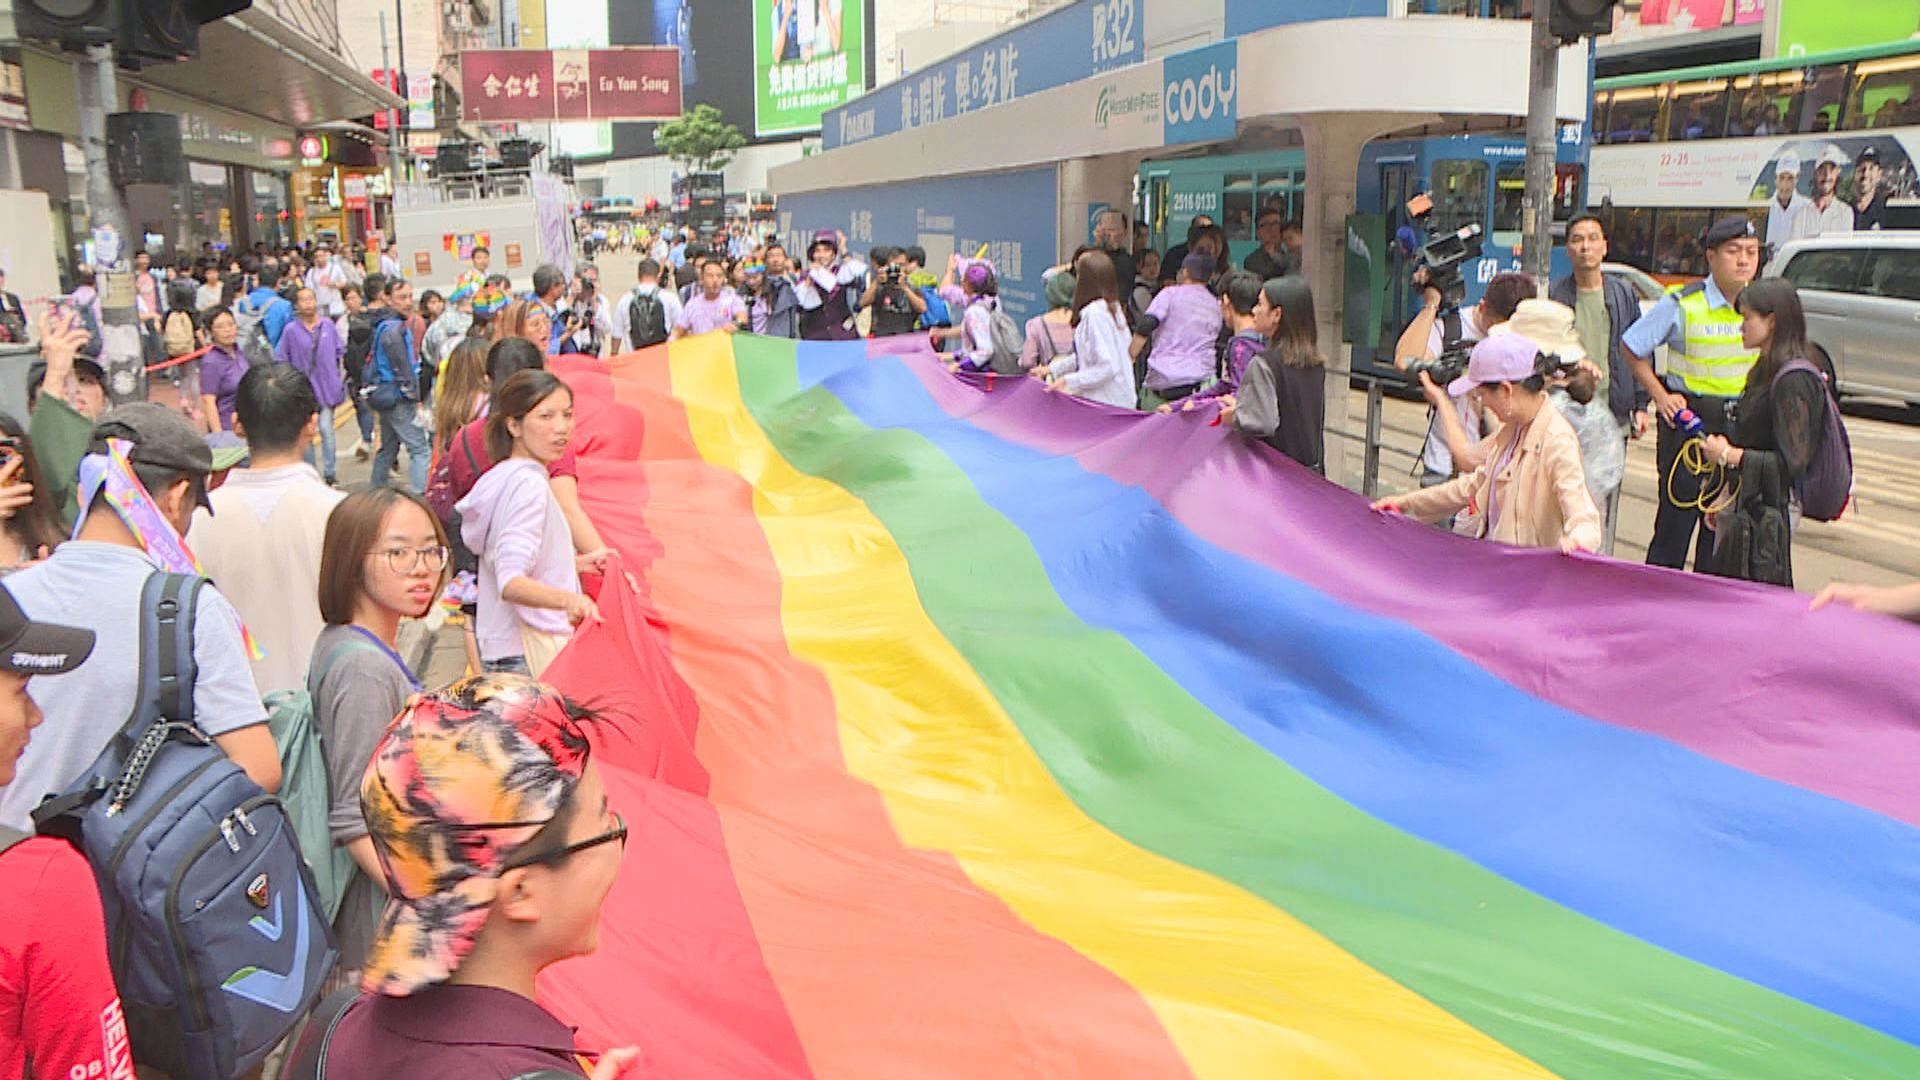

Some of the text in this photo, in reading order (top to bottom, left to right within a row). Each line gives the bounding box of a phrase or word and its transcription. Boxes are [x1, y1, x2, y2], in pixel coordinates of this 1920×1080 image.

[1092, 0, 1135, 63] R32
[482, 73, 540, 98] 余仁生
[600, 75, 670, 94] Eu Yan Sang
[1165, 64, 1236, 126] cody
[1195, 191, 1216, 211] 0133
[103, 996, 137, 1080] HELV
